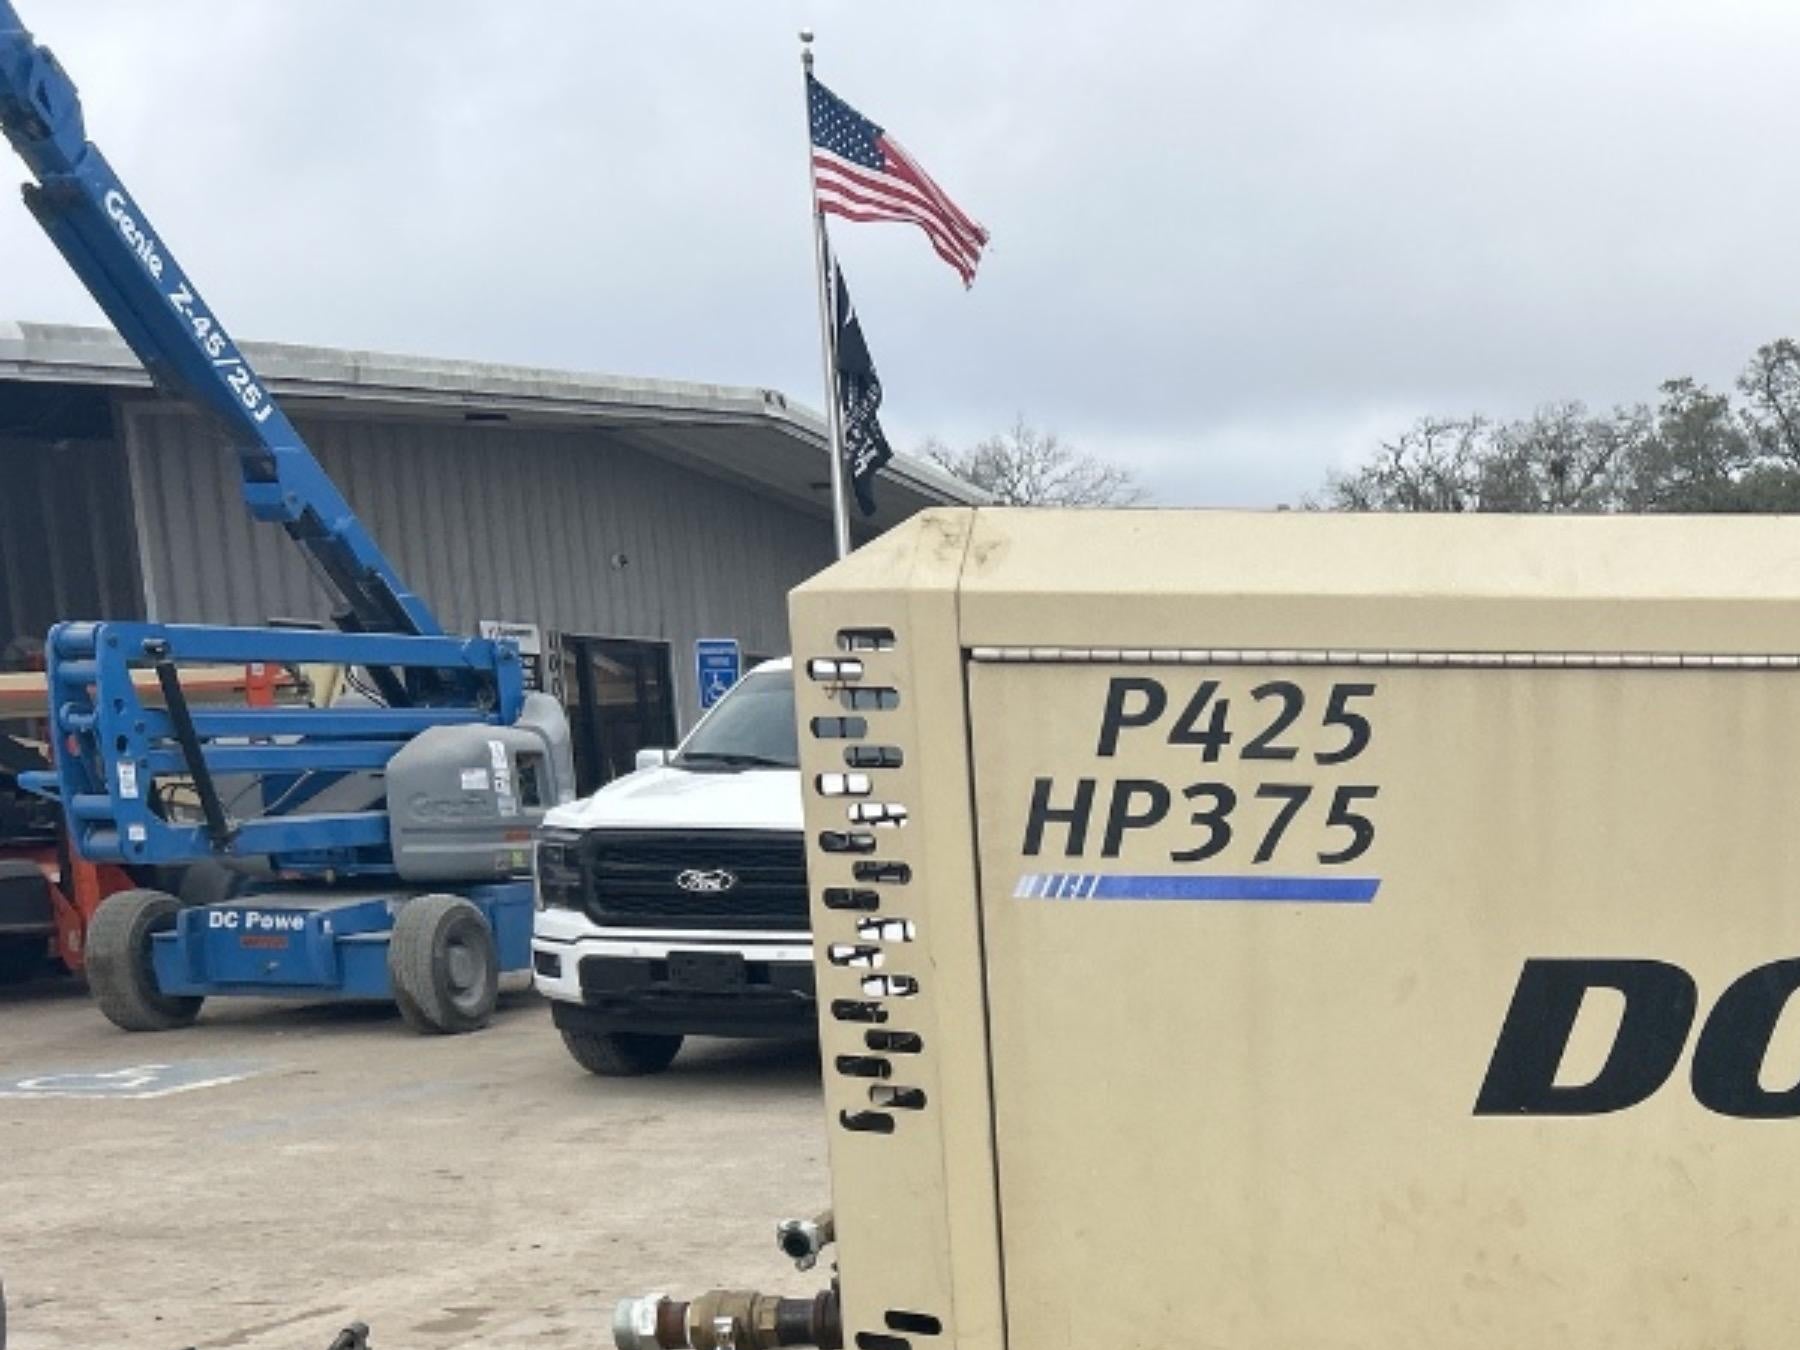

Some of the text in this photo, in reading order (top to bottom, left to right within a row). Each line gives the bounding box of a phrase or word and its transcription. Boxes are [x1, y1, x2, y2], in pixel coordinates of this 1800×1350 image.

[105, 189, 273, 422] Genie Z-45/25J
[1096, 677, 1377, 765] P425
[1021, 777, 1380, 864] HP375
[209, 911, 239, 928] DC
